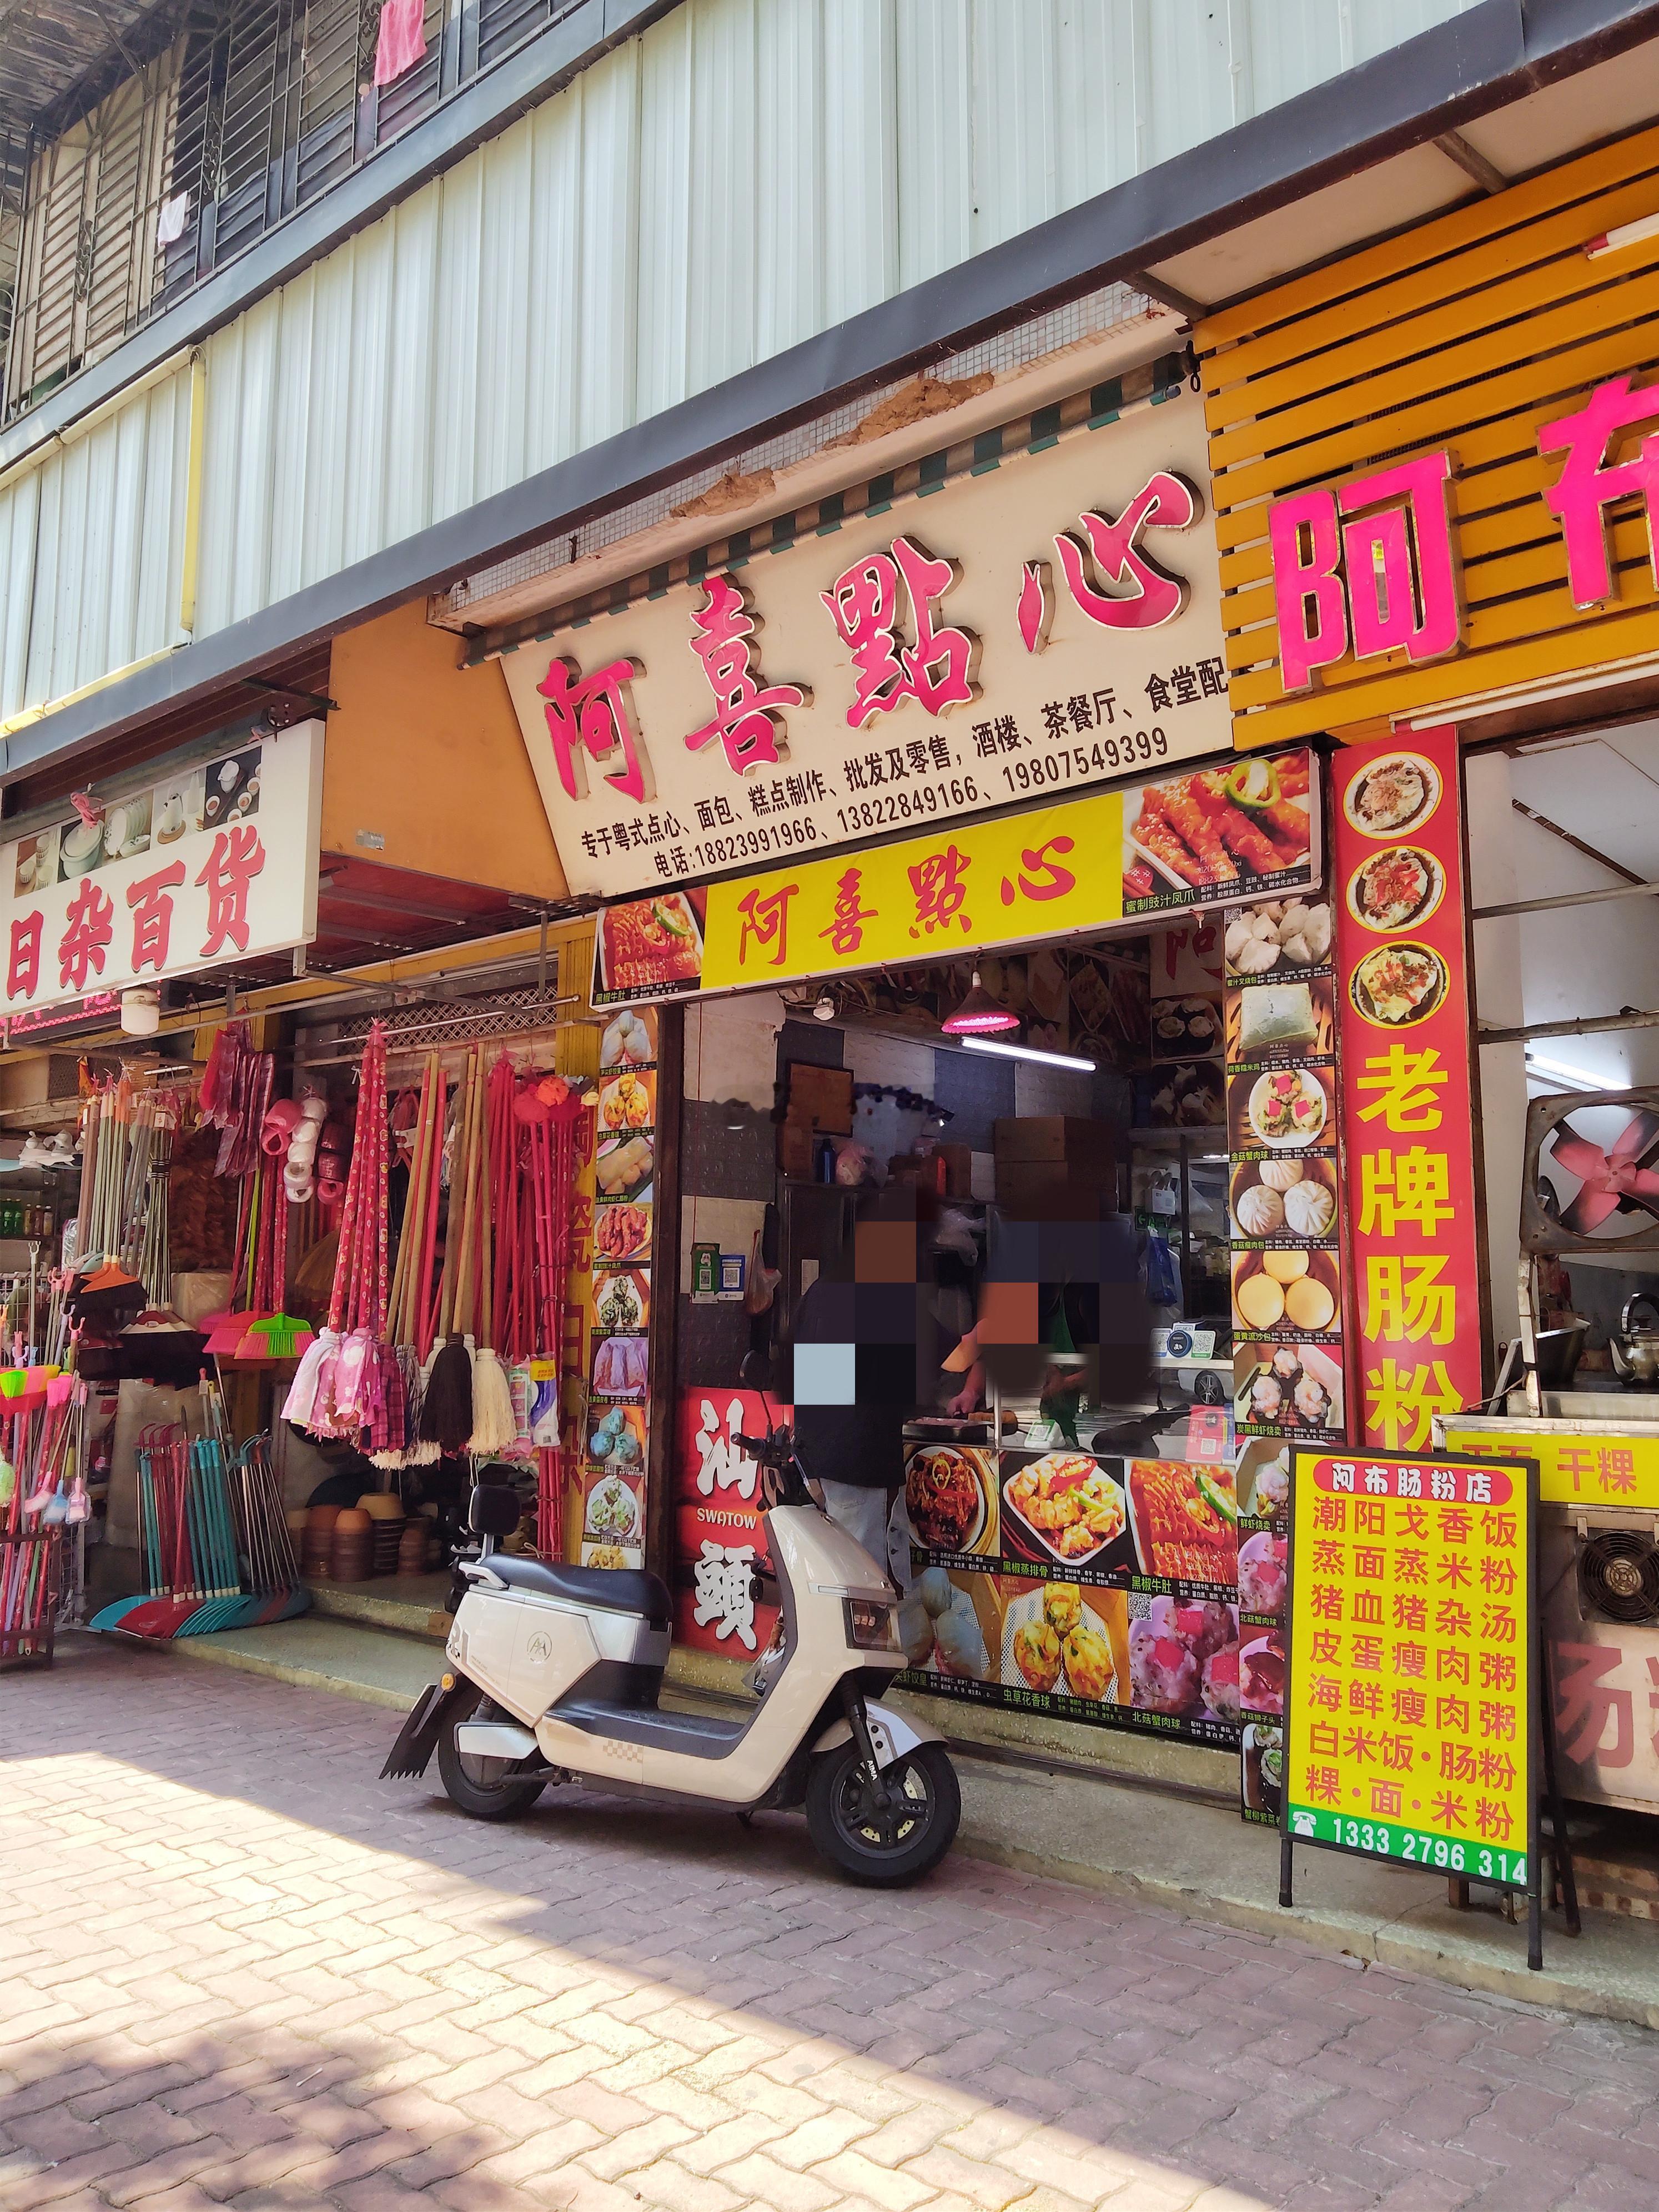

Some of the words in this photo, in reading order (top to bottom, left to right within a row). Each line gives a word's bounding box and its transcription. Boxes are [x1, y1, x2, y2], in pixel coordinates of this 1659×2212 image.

[536, 469, 1197, 803] 阿喜點心
[7, 825, 265, 999] 日杂百货
[737, 836, 1075, 966] 阿喜點心
[1358, 1043, 1462, 1451] 老牌肠粉
[696, 1398, 758, 1500] 汕
[1237, 1424, 1281, 1436] 炭黑鲜虾烧卖
[1333, 1464, 1492, 1504] 阿布肠粉店
[1557, 1447, 1637, 1494] 干粿
[696, 1508, 757, 1530] SWATOW
[1240, 1518, 1270, 1531] 鲜虾烧卖
[1313, 1496, 1518, 1549] 潮阳戈香饭
[1003, 1561, 1048, 1578] 黑椒蒸排骨
[1132, 1576, 1172, 1593] 黑椒牛肚
[1312, 1539, 1518, 1596] 蒸面蒸米粉
[1240, 1614, 1277, 1626] 北菇蟹肉球
[1311, 1583, 1517, 1643] 猪血猪杂汤
[1309, 1629, 1517, 1693] 皮蛋瘦肉粥
[1003, 1689, 1050, 1710] 虫草花香球
[1133, 1711, 1180, 1730] 北菇蟹肉球
[1308, 1672, 1517, 1742] 海鲜瘦肉粥
[867, 1760, 877, 1781] AIMA
[1333, 1817, 1390, 1853] 1333
[1402, 1836, 1466, 1872] 2796
[1478, 1851, 1527, 1886] 314
